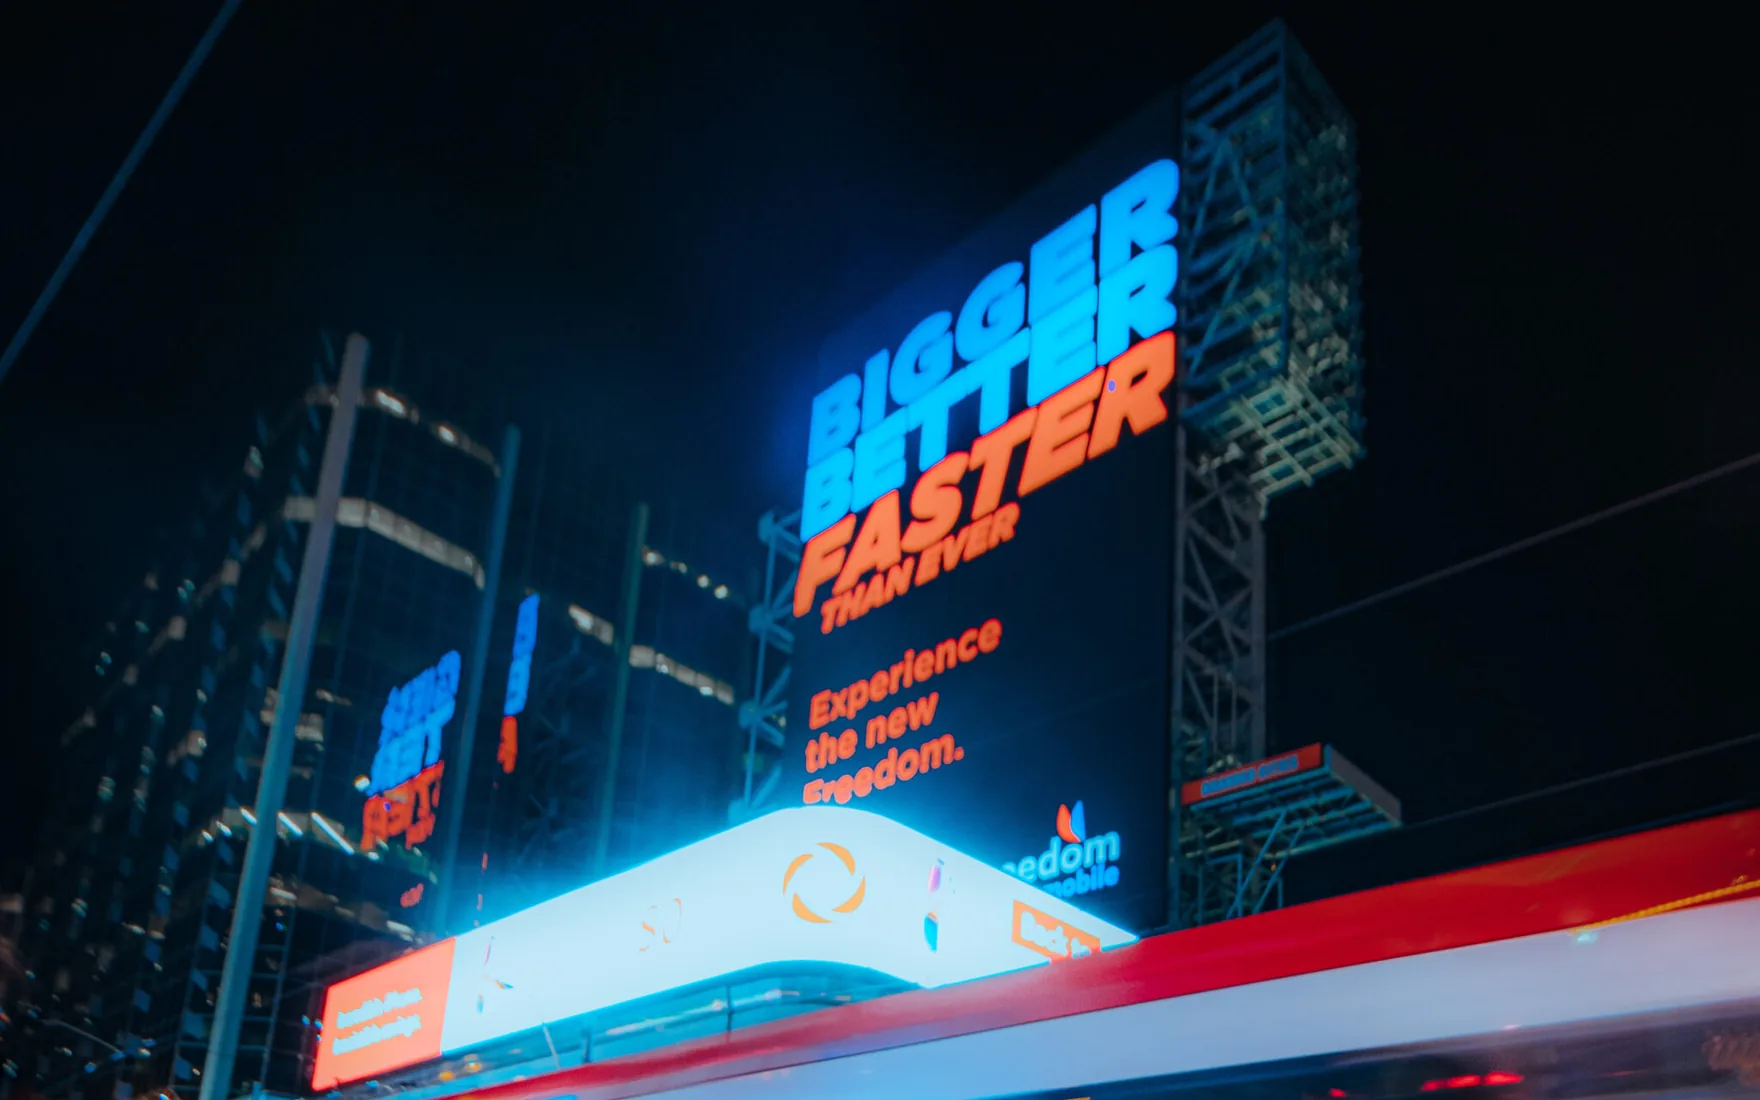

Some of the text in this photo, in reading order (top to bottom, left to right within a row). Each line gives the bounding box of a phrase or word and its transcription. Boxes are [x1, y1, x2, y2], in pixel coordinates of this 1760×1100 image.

[807, 158, 1180, 468] BIGGER
[800, 243, 1179, 543] BETTER
[793, 330, 1176, 618] FASTER
[820, 501, 1021, 635] THAN EVER
[805, 691, 940, 774] the new
[808, 618, 1003, 730] Experience
[802, 733, 965, 805] Freedom.
